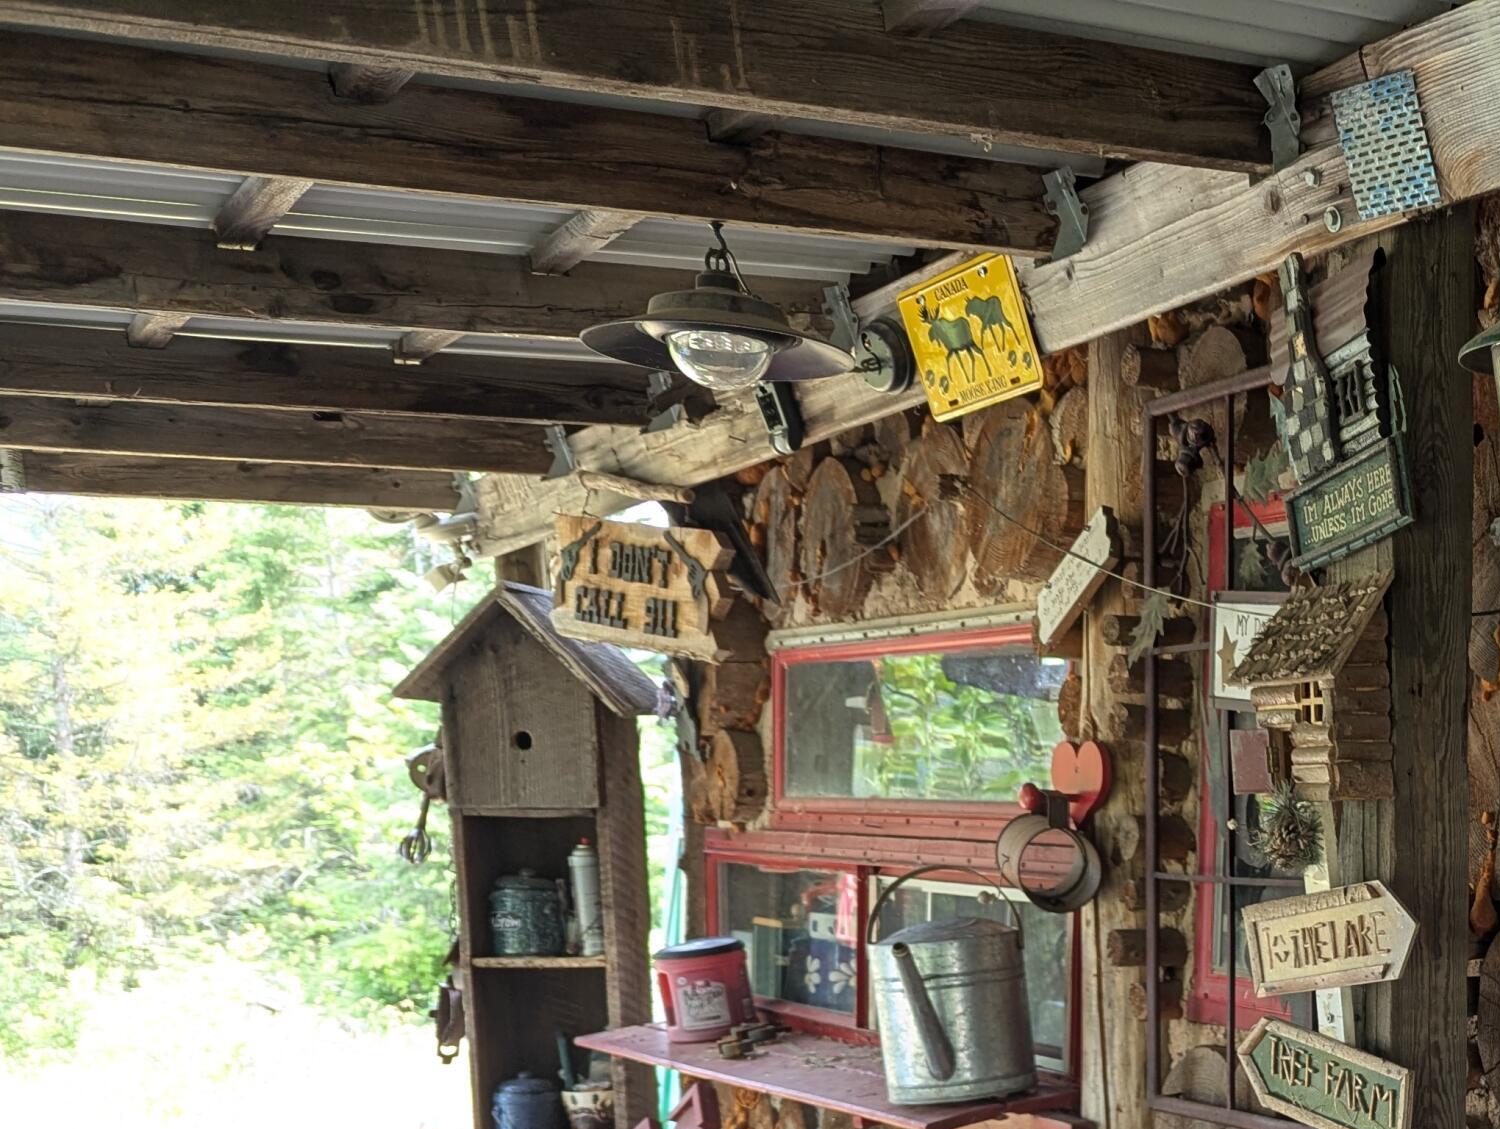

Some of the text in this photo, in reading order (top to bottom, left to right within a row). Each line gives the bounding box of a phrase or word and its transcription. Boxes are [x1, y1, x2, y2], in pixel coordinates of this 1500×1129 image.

[934, 278, 969, 302] CANADA
[959, 375, 1008, 403] MOOSE X-ING
[1323, 478, 1364, 515] ALWAYS
[1366, 463, 1392, 494] HERE
[1368, 488, 1395, 516] GONE
[608, 541, 672, 588] DON'T
[575, 585, 679, 638] CALL 911
[1236, 614, 1250, 637] MY
[1268, 1035, 1398, 1129] TREE FARM
